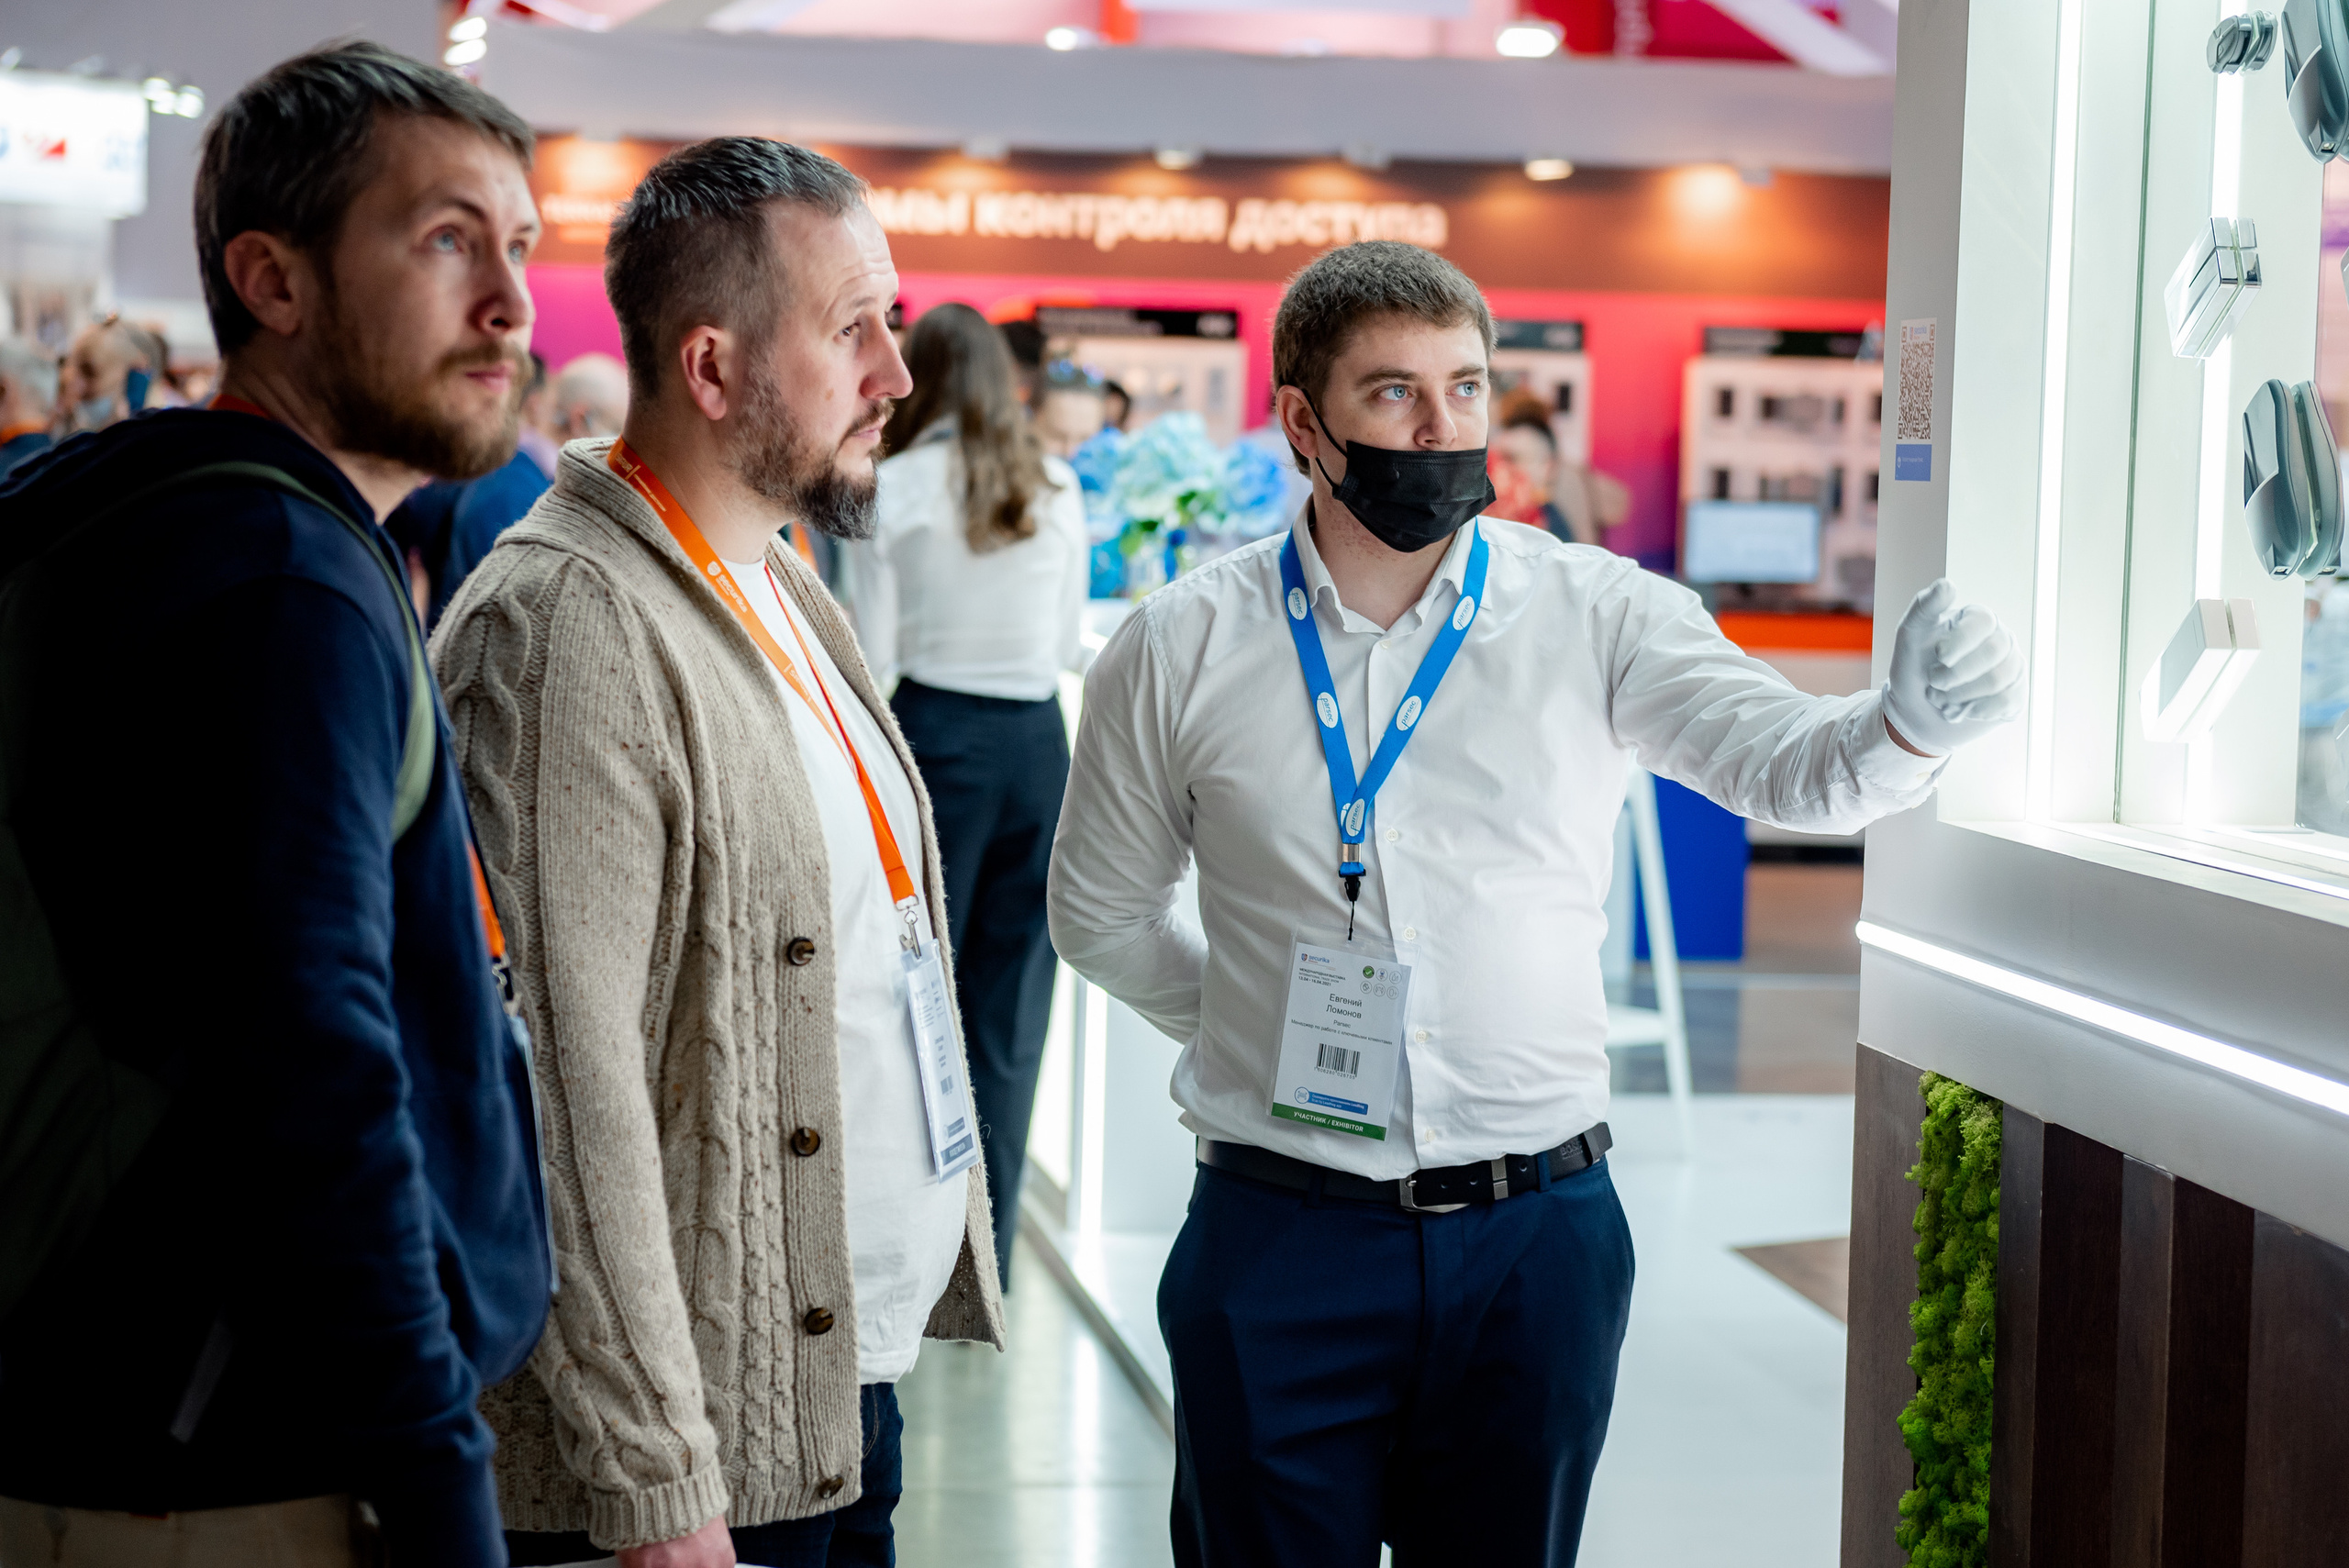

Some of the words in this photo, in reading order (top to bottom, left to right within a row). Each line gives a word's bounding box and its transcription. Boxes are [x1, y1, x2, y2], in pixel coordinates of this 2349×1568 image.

[1457, 600, 1471, 628] parsec
[1318, 697, 1334, 722] parsec
[1401, 700, 1417, 728] parsec
[1350, 804, 1361, 831] parsec
[1308, 955, 1330, 963] securika
[1329, 994, 1363, 1007] Евгений
[1326, 1005, 1362, 1018] Ломонов
[1291, 1019, 1314, 1029] Менеджер
[1321, 1026, 1337, 1034] работе
[1333, 1019, 1351, 1029] Parsec
[1294, 1111, 1327, 1124] УЧАСТНИК
[1331, 1119, 1364, 1132] EXHIBITOR
